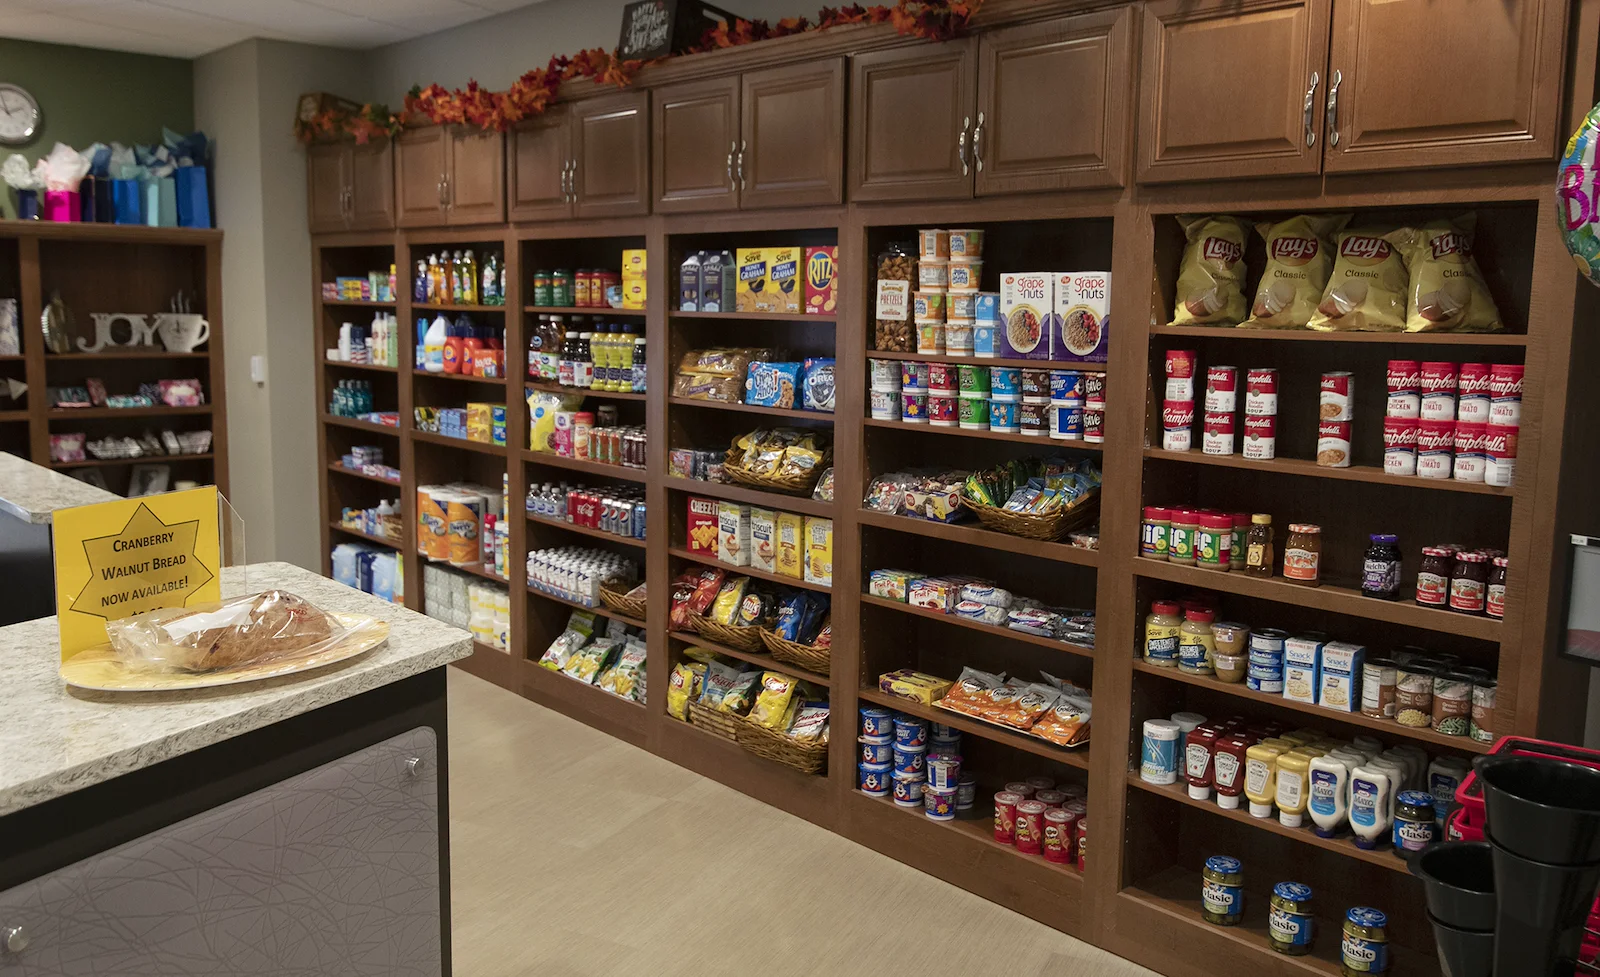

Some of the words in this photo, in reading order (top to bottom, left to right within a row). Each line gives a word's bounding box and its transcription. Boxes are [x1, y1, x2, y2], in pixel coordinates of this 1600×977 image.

[1206, 238, 1241, 260] Lay's
[1276, 237, 1318, 258] Lay's
[1343, 236, 1391, 258] Lay's
[741, 268, 764, 280] GRAHAM
[772, 268, 795, 280] GRAHAM
[810, 258, 832, 284] RITZ
[1274, 270, 1306, 280] Classic
[1345, 269, 1378, 279] Classic
[1018, 278, 1044, 292] grape
[1074, 277, 1104, 292] grape
[880, 294, 903, 306] PRETZELS
[76, 313, 163, 353] JOY
[755, 370, 773, 384] Chips
[690, 500, 719, 515] CHEEZ-IT
[720, 516, 737, 528] triscuit
[752, 521, 772, 534] triscuit
[113, 532, 174, 552] CRANBERRY
[102, 561, 150, 581] WALNUT
[152, 554, 186, 571] BREAD
[102, 592, 130, 607] NOW
[132, 576, 188, 600] AVAILABLE!
[1289, 650, 1311, 659] Snack
[1326, 656, 1348, 666] Snack
[1313, 786, 1333, 796] MAYO
[1354, 795, 1373, 806] MAYO
